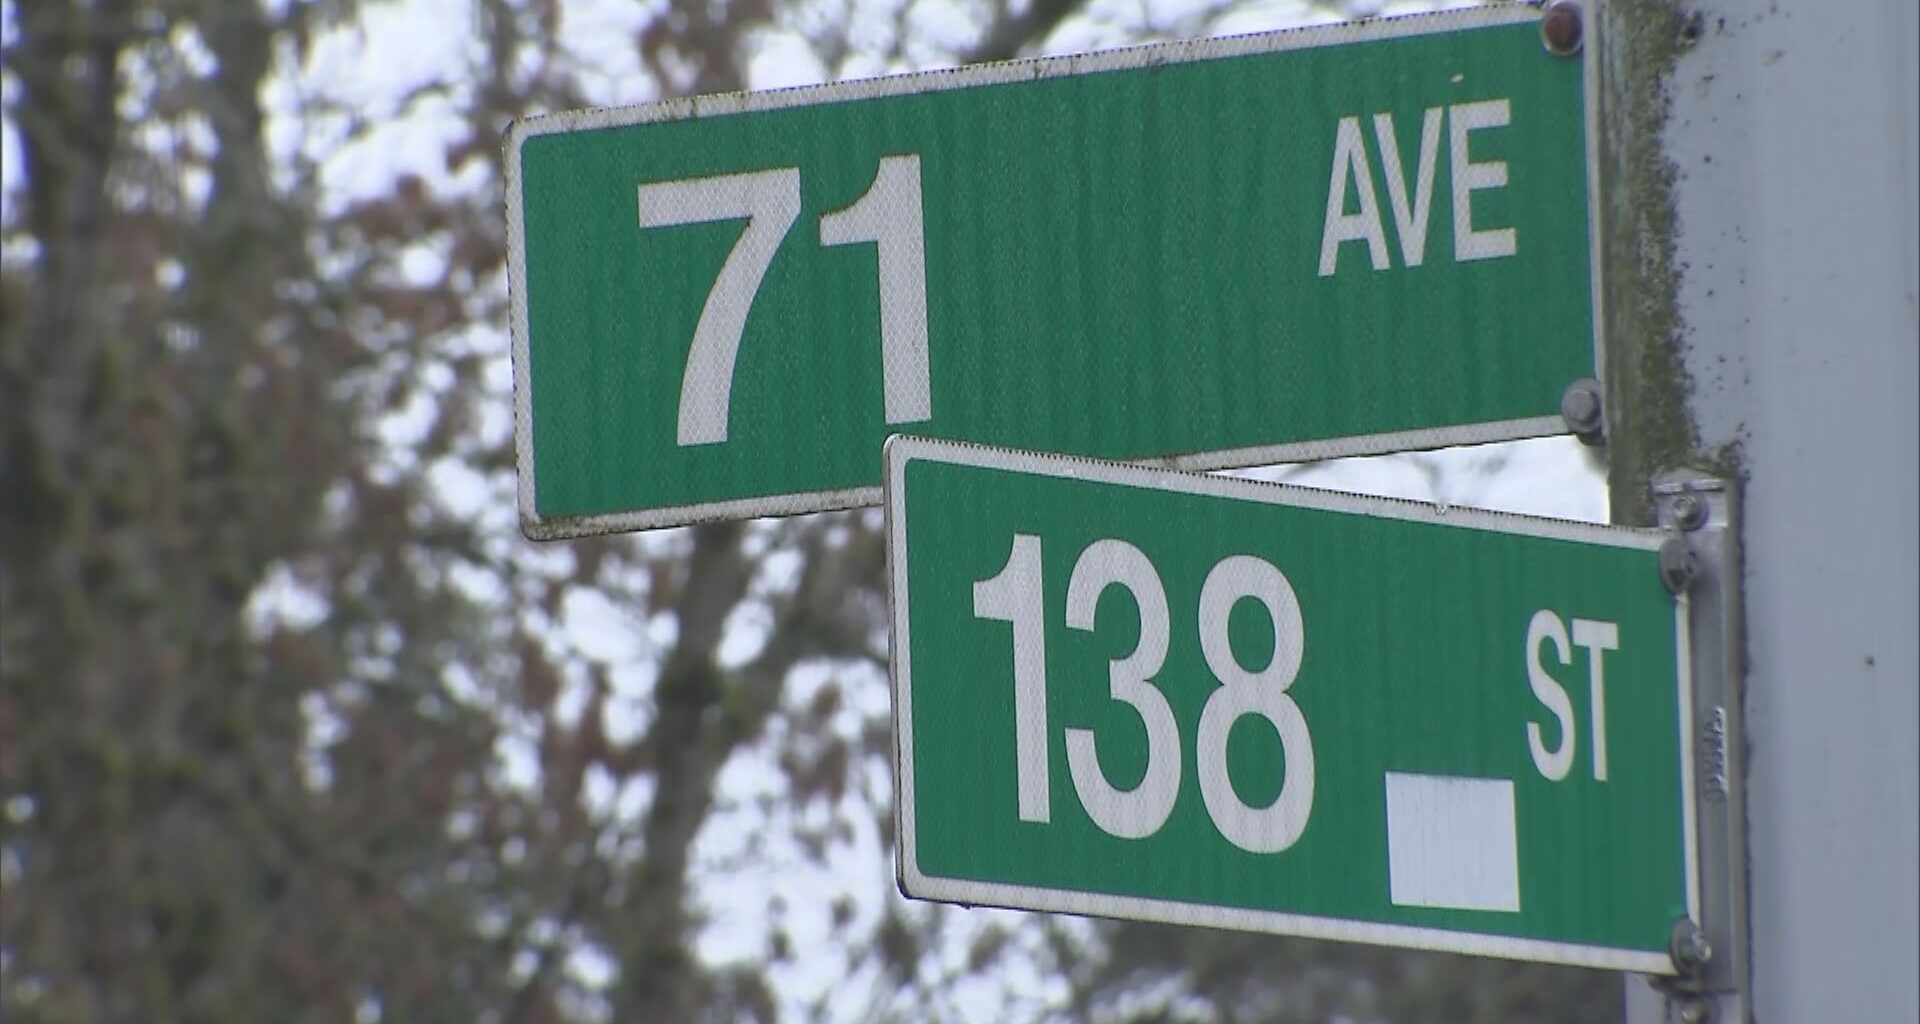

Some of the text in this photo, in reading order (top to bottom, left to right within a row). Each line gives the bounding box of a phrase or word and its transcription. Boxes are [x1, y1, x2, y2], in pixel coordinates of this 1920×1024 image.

[637, 98, 1517, 447] 71 AVE
[972, 532, 1620, 855] 138 ST
